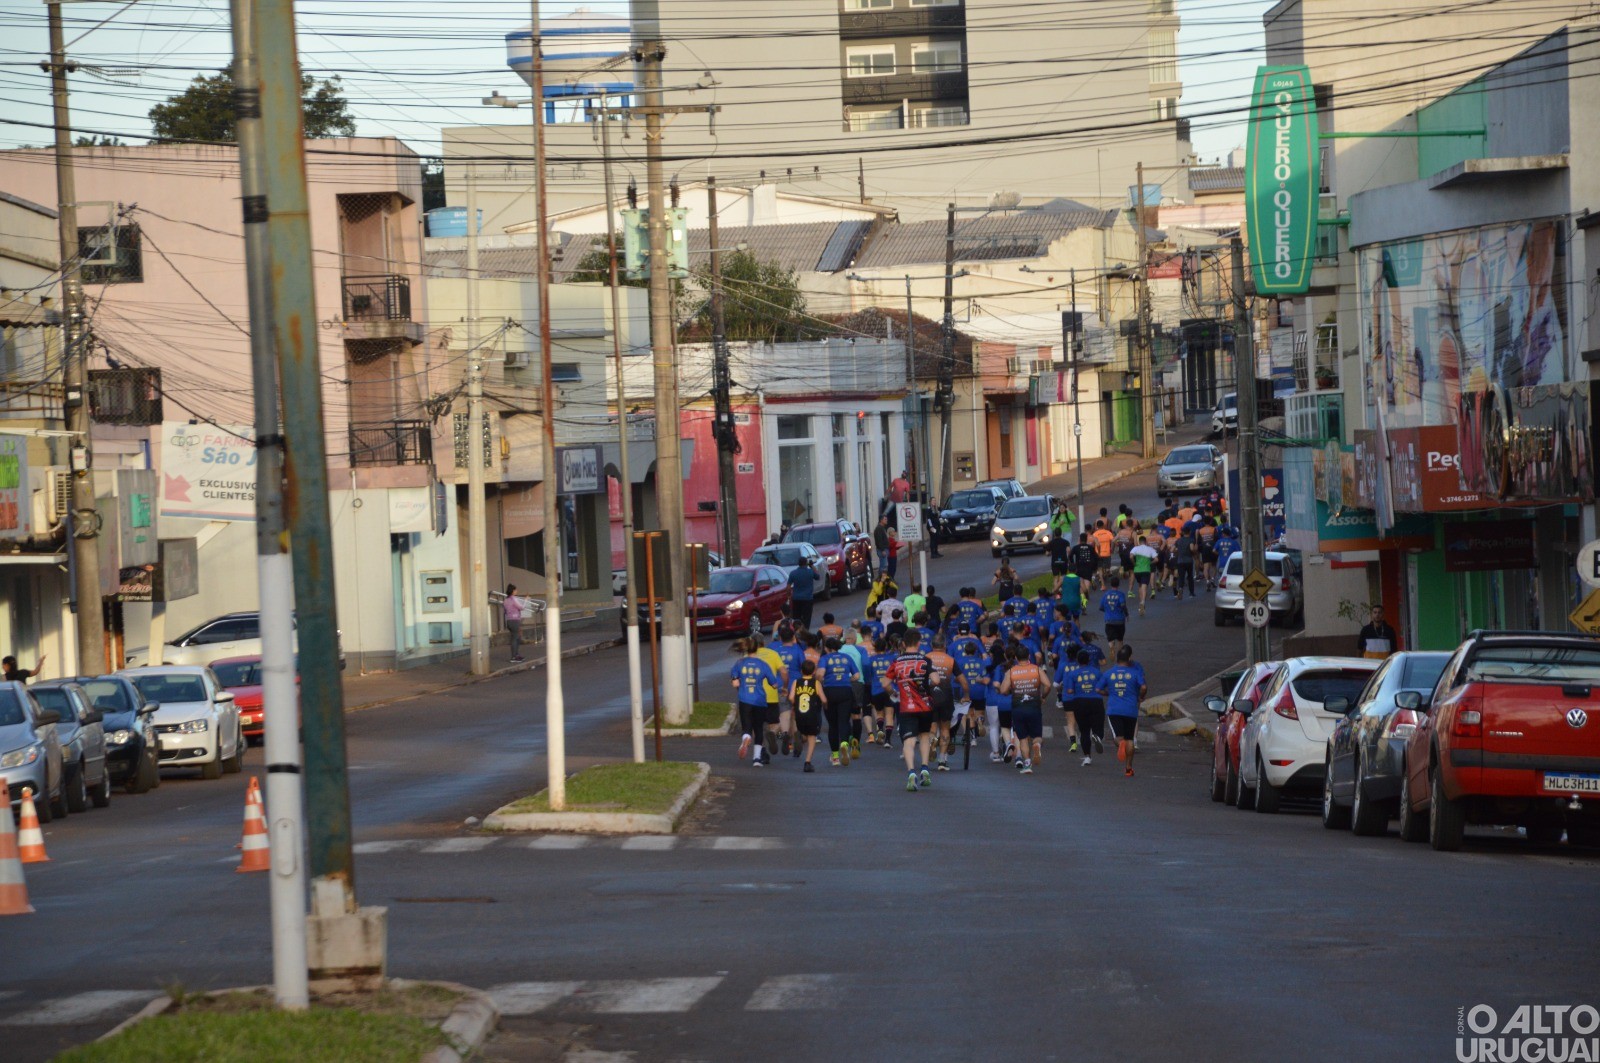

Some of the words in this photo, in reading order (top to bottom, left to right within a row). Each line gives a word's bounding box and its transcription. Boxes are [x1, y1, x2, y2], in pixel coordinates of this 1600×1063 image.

[201, 446, 240, 465] São
[203, 490, 256, 502] CLIENTES
[1250, 606, 1264, 617] 40
[799, 693, 811, 714] 6
[1548, 777, 1599, 790] MLC3H11
